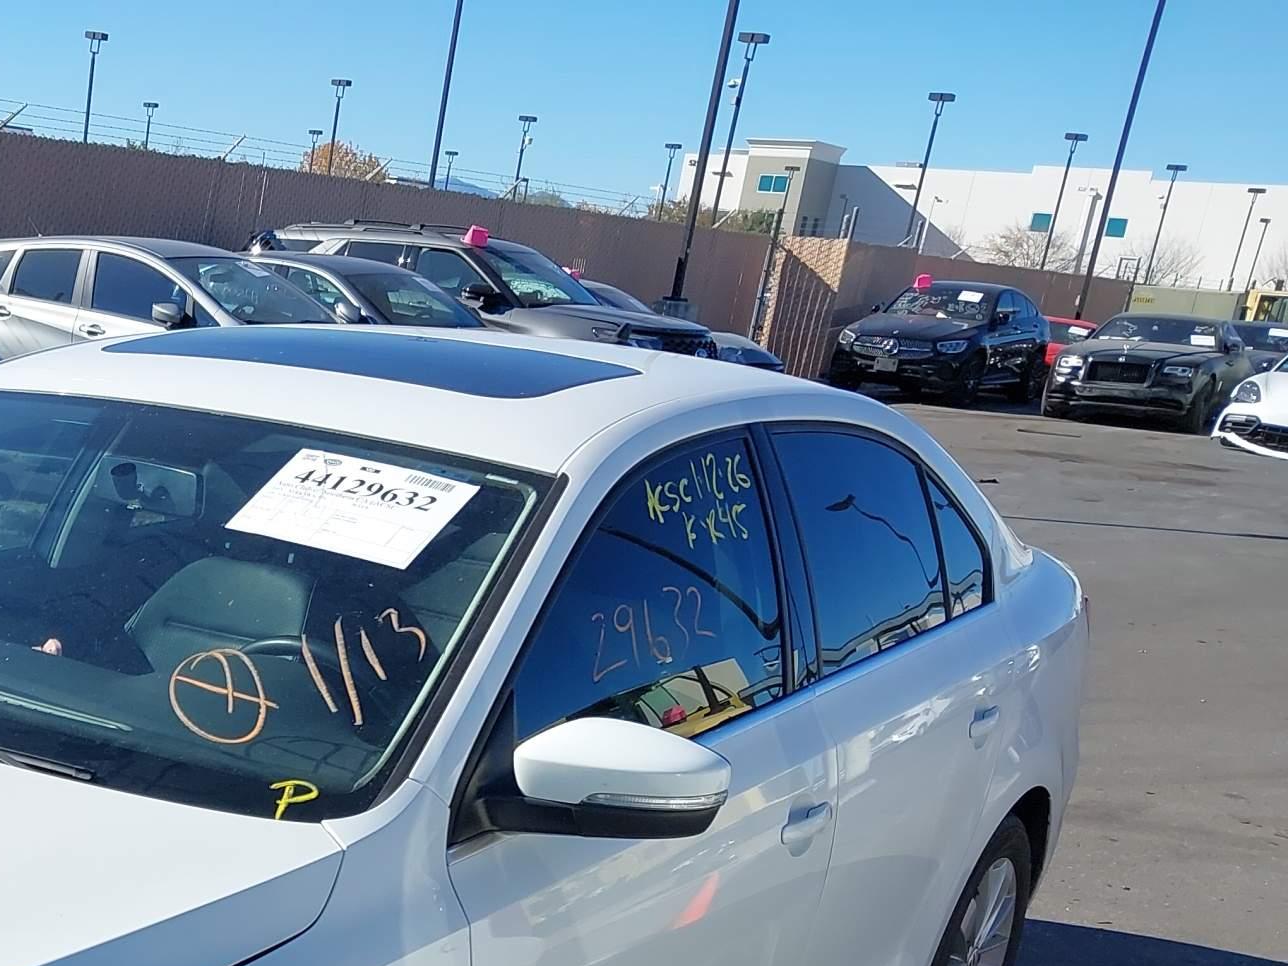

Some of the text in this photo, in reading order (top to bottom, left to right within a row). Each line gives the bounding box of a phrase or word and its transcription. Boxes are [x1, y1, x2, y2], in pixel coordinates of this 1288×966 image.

[294, 468, 439, 513] 44129632
[301, 607, 427, 727] 1/13
[591, 586, 717, 682] 29632
[269, 779, 320, 821] P
